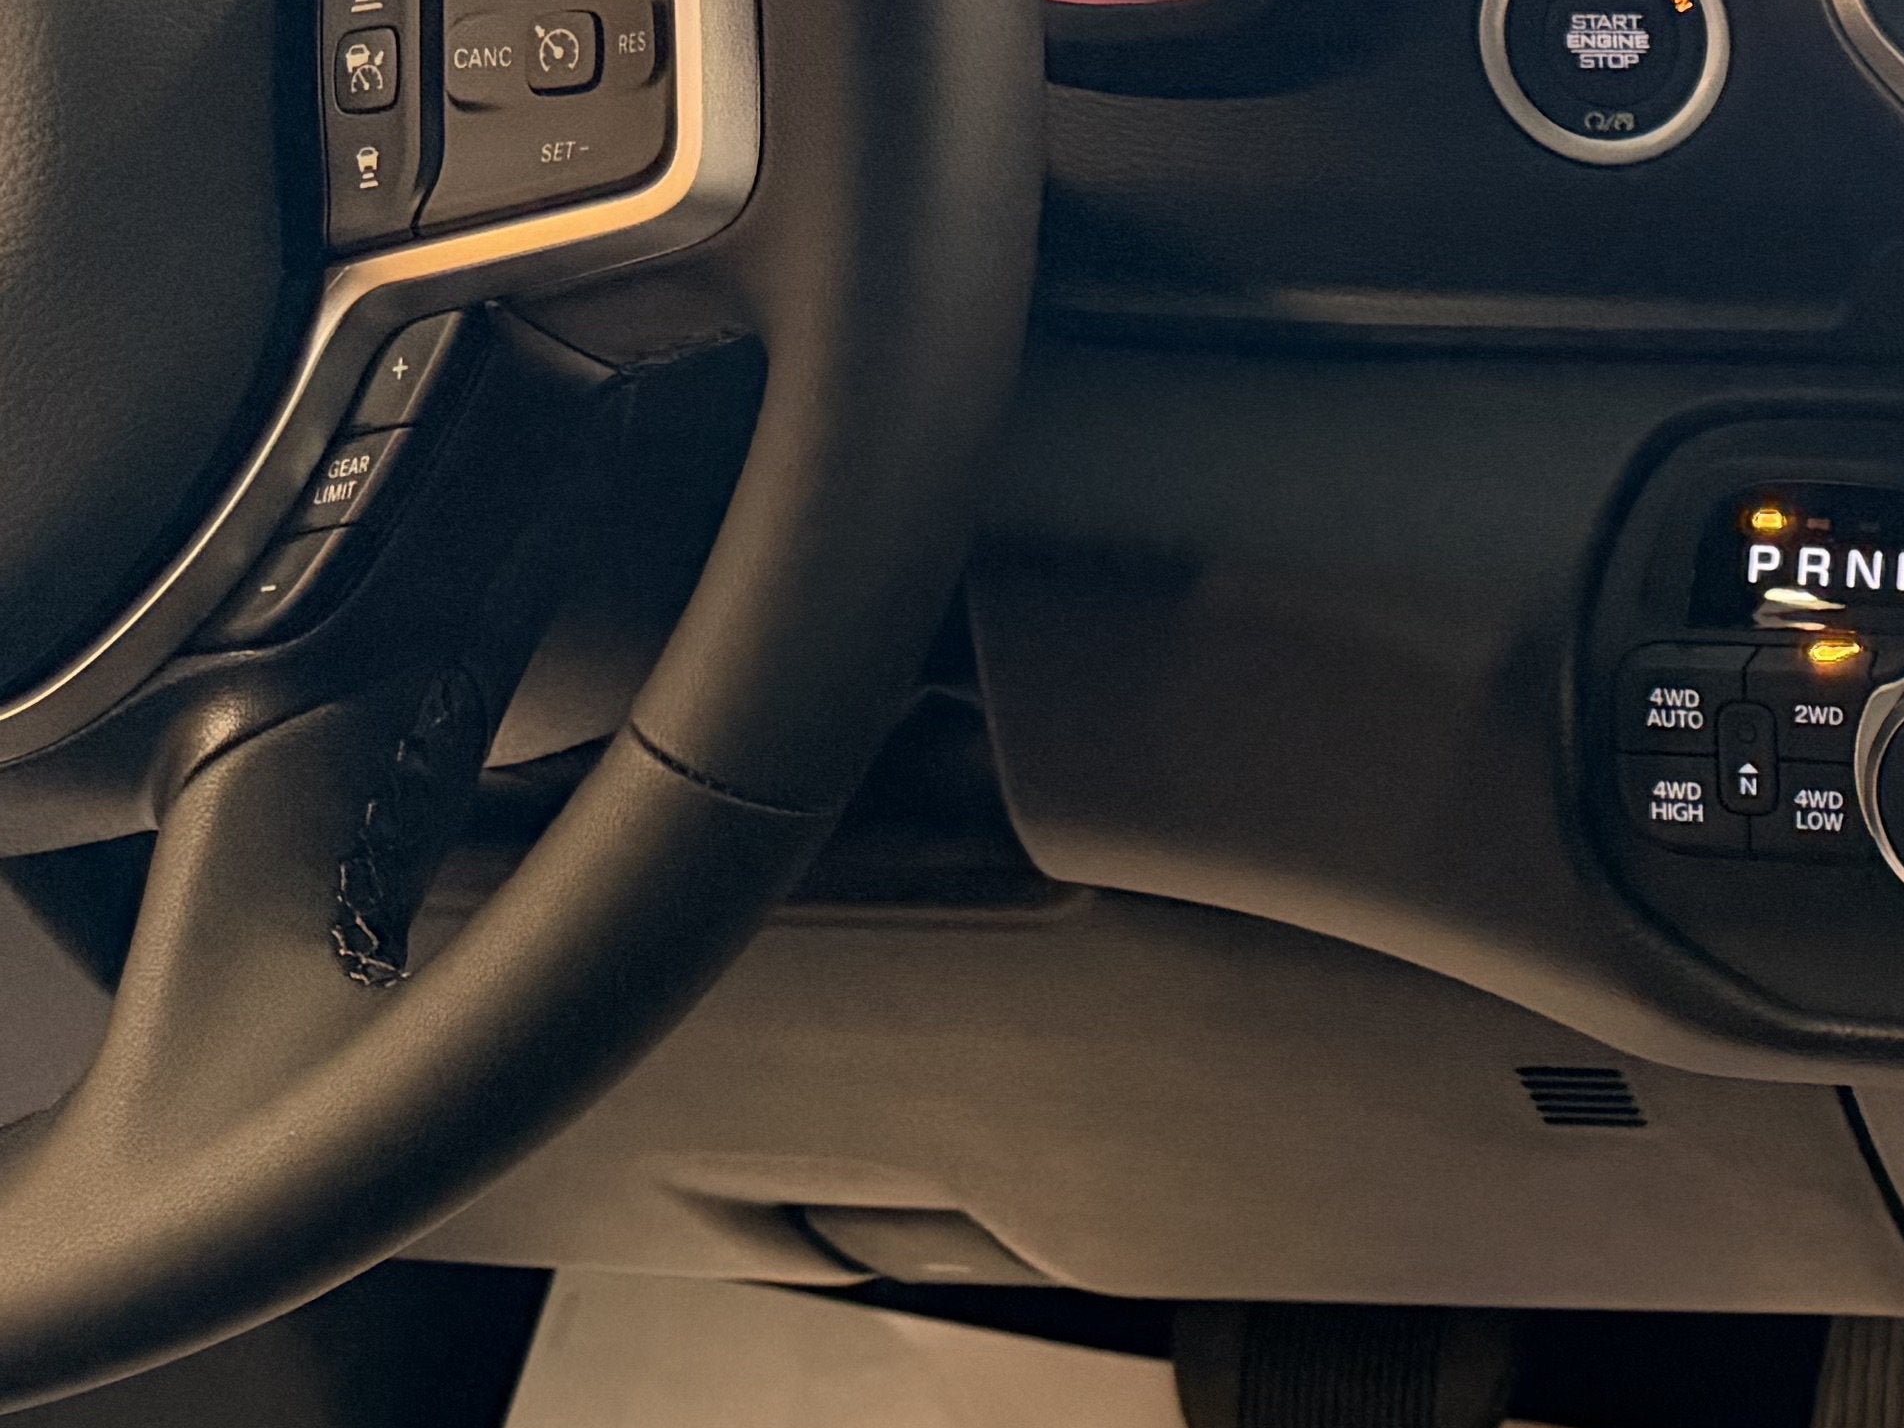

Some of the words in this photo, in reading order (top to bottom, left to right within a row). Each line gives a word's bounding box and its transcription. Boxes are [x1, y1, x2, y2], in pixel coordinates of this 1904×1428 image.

[1571, 14, 1643, 30] START
[618, 32, 646, 54] RES
[1566, 33, 1650, 49] ENGINE
[454, 46, 512, 69] CANC
[1579, 54, 1640, 69] STOP
[328, 455, 370, 479] GEAR
[314, 480, 355, 505] LIMIT
[1650, 689, 1700, 708] 4WD
[1647, 709, 1703, 730] AUTO
[1795, 705, 1843, 726] 2WD
[1652, 782, 1701, 801] 4WD
[1740, 777, 1757, 796] N
[1795, 790, 1843, 810] 4WD
[1651, 802, 1704, 823] HIGH
[1796, 811, 1843, 831] LOW
